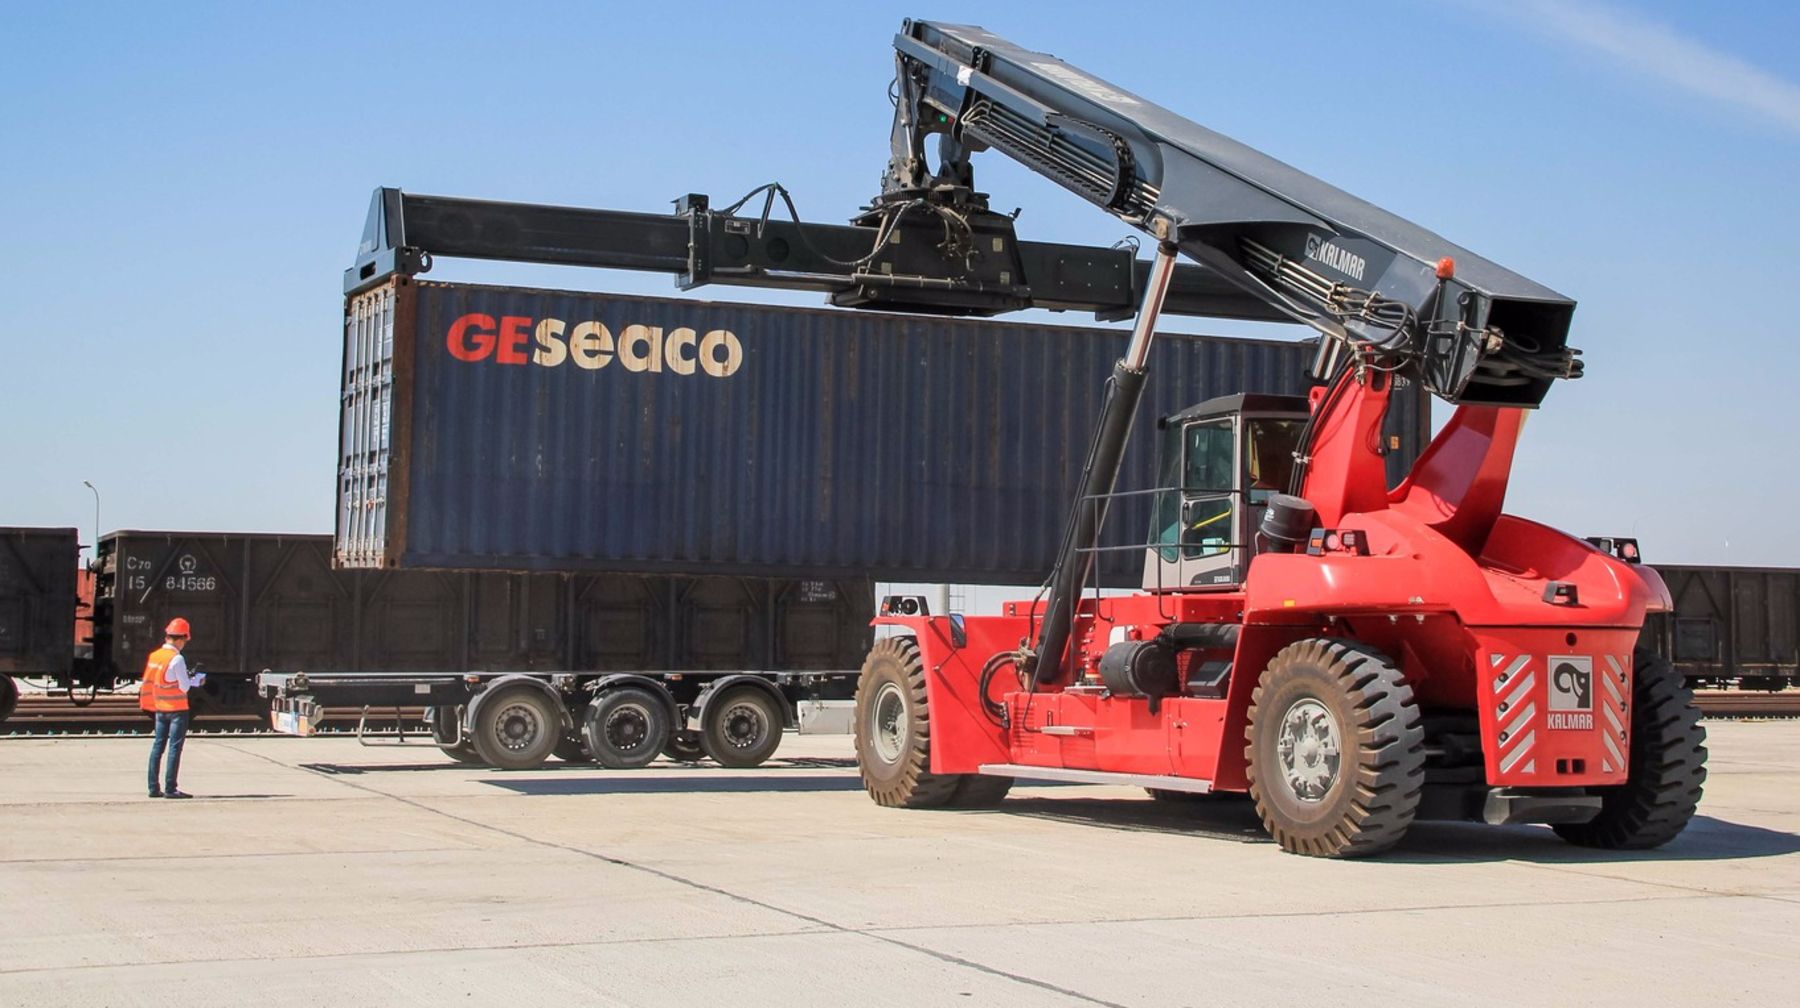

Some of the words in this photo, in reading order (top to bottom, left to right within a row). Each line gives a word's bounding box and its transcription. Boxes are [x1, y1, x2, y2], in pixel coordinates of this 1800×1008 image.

[1318, 240, 1366, 281] KALMAR
[128, 575, 146, 590] 15
[165, 576, 216, 591] 84566
[1547, 713, 1594, 730] KALMAR
